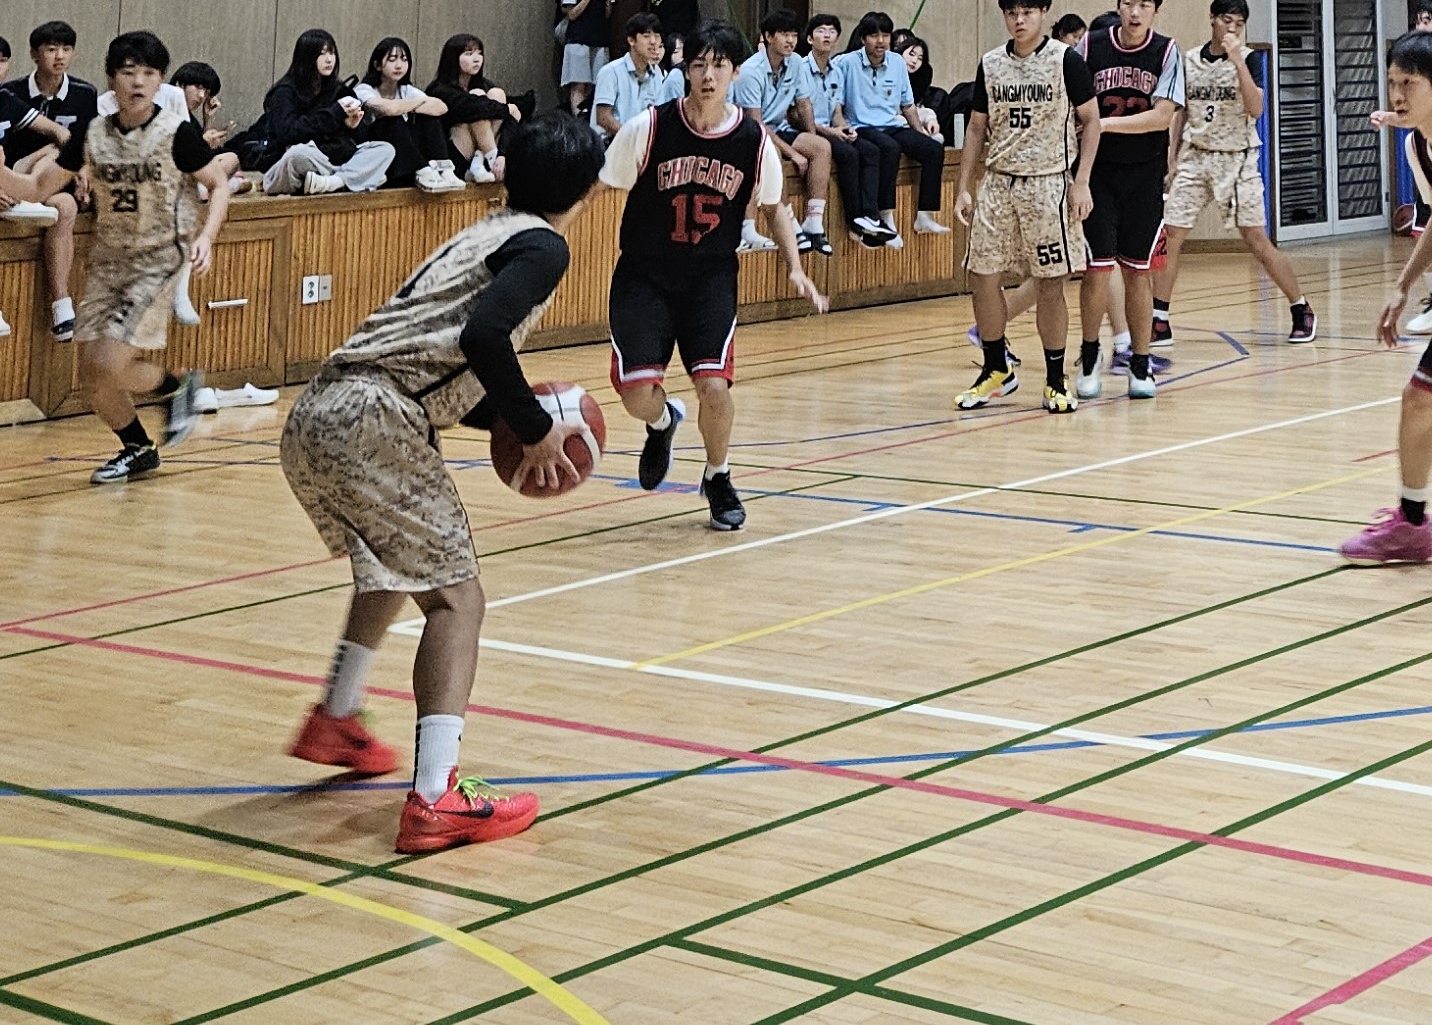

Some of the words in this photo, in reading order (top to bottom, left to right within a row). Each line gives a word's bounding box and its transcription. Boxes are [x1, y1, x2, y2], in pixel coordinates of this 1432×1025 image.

[1009, 106, 1032, 129] 55
[1204, 105, 1215, 123] 3
[657, 155, 745, 201] CHICAGO
[111, 188, 139, 213] 29
[670, 194, 724, 245] 15
[1036, 242, 1063, 266] 55
